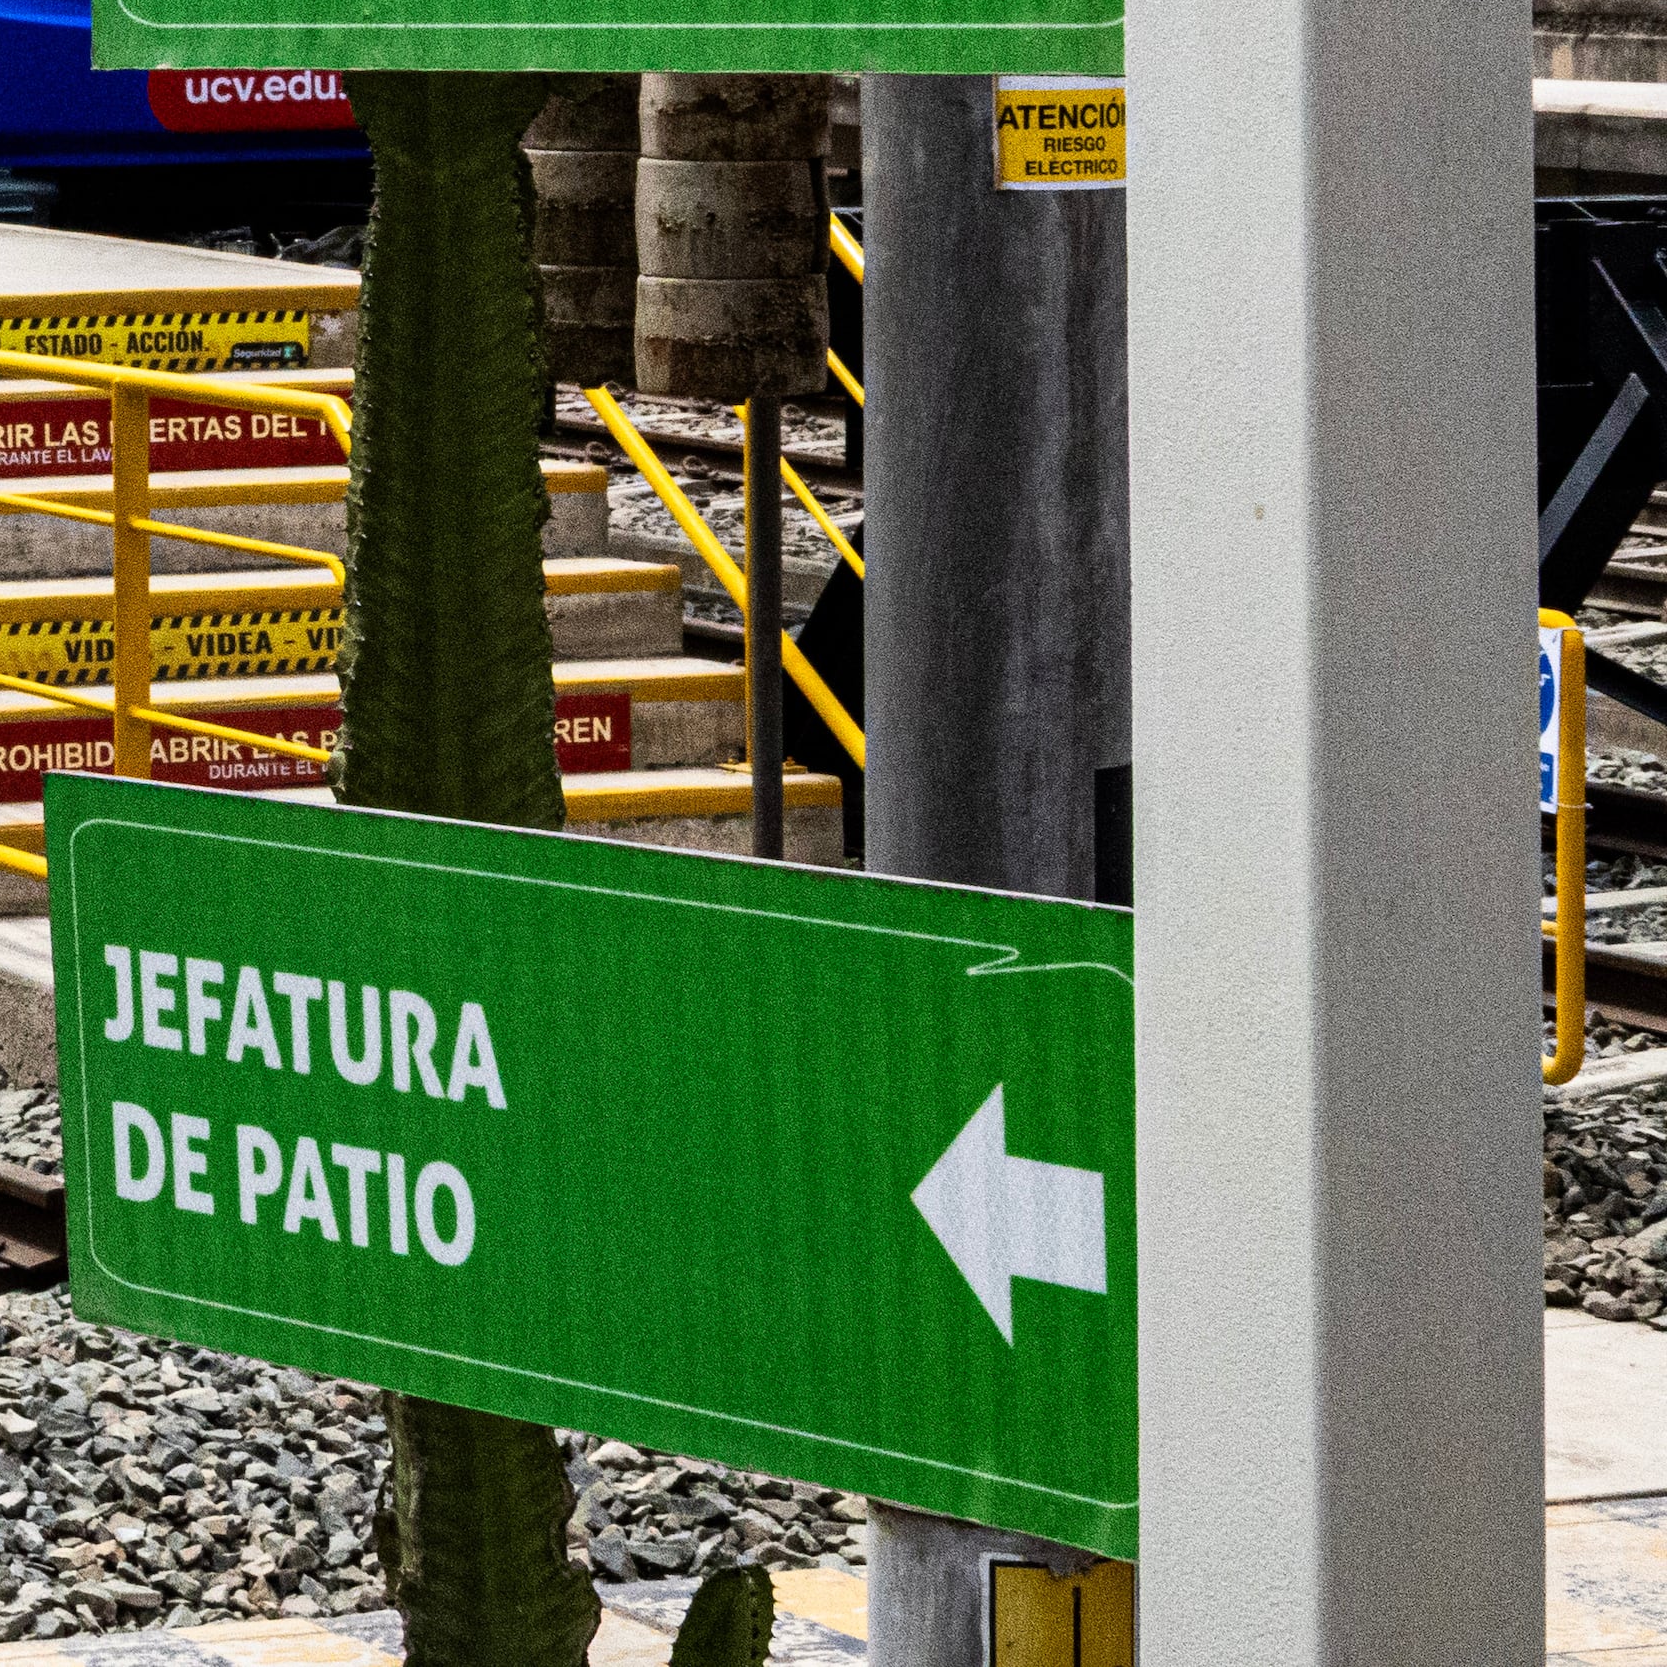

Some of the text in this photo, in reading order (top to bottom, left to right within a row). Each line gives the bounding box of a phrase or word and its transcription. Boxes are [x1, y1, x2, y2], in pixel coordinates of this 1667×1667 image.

[185, 70, 347, 103] ucv.edu.
[1044, 136, 1106, 152] RIESGO
[25, 333, 103, 356] ESTADO
[44, 419, 101, 447] LAS
[110, 414, 242, 444] ERTAS
[251, 413, 307, 440] DEL
[57, 448, 76, 464] EL
[186, 630, 272, 657] VIDEA
[553, 716, 612, 744] REN
[210, 762, 291, 780] DURANTE
[296, 760, 317, 775] EL
[102, 944, 509, 1111] JEFATURA
[112, 1100, 476, 1267] DE PATIO
